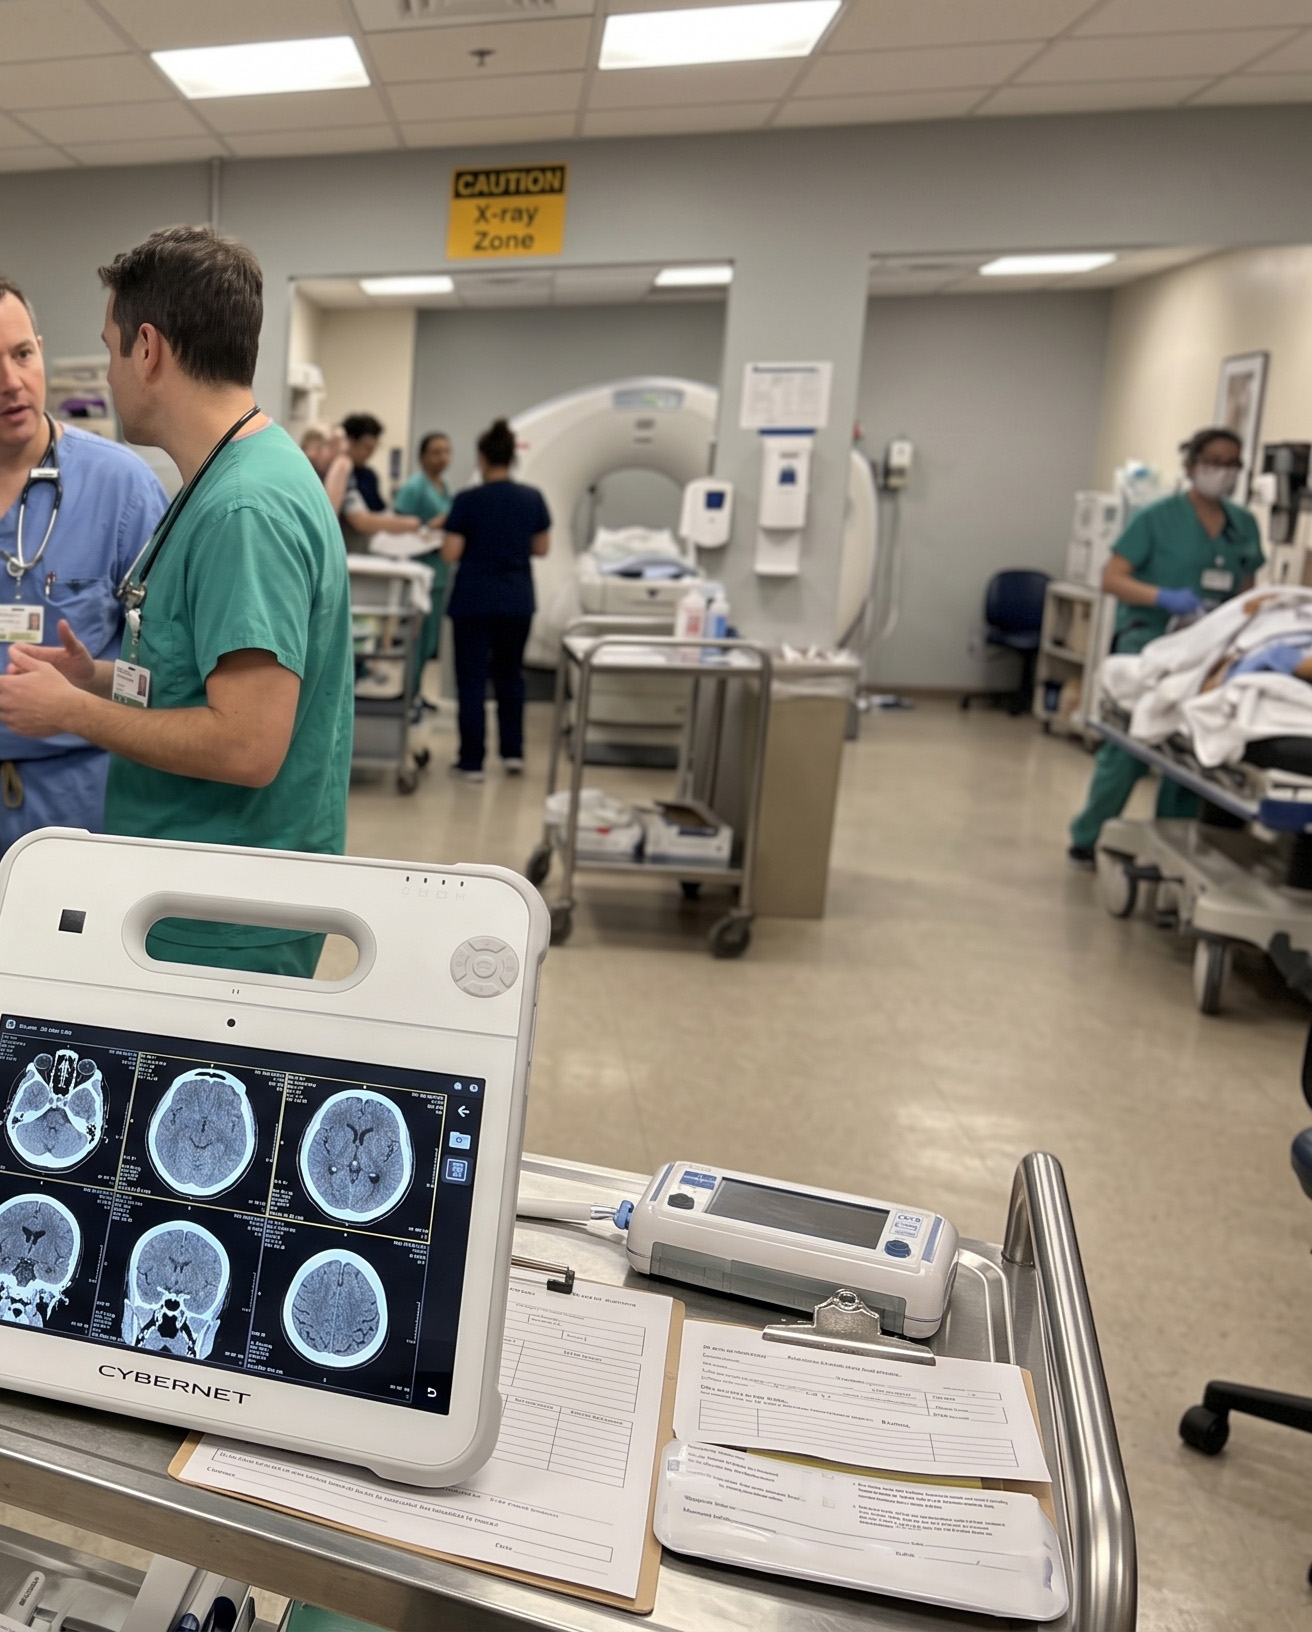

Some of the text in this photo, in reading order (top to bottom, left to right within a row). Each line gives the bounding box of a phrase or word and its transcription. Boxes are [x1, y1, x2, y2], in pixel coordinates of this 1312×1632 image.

[456, 169, 562, 196] CAUTION
[474, 204, 540, 227] X-ray
[472, 232, 535, 252] Zone
[98, 1364, 251, 1405] CYBERNET
